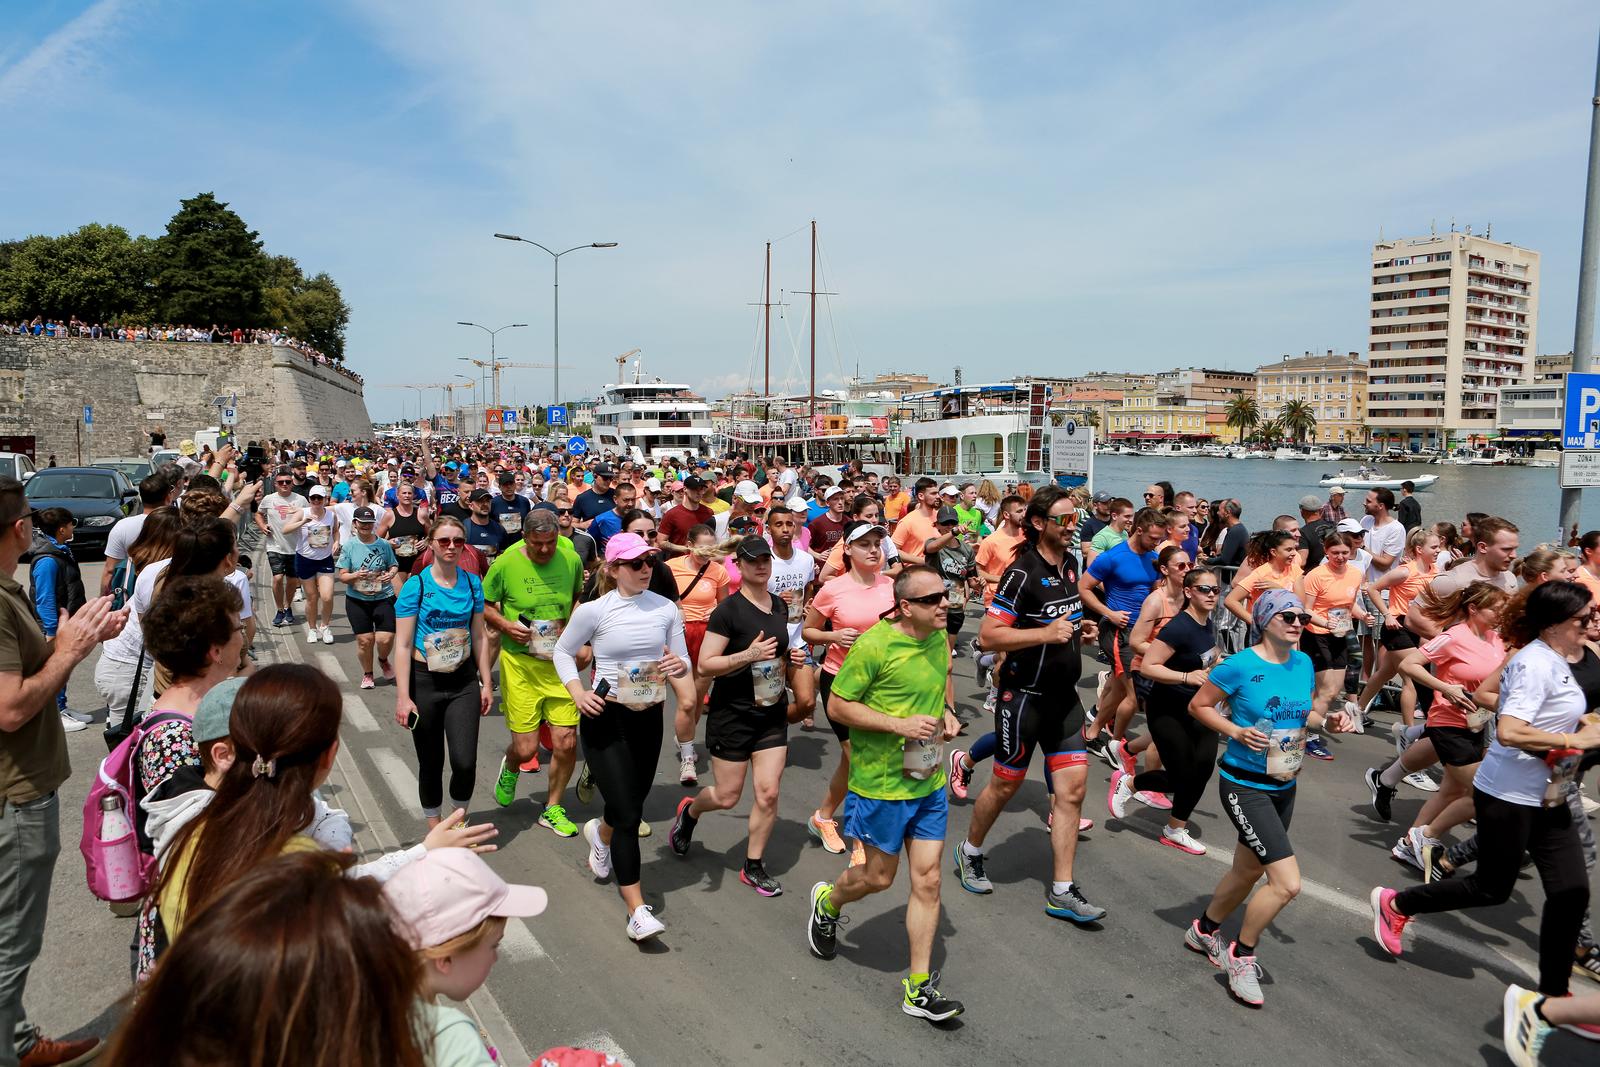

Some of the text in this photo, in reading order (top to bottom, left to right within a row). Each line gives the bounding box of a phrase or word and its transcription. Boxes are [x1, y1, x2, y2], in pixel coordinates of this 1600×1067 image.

[552, 409, 560, 422] P
[1579, 387, 1600, 433] P
[507, 412, 513, 422] P
[1577, 454, 1592, 462] ZONA
[360, 547, 380, 569] TEAM
[775, 573, 803, 583] ZADAR
[776, 581, 804, 590] ZADAR
[1058, 600, 1083, 615] GIAN
[441, 650, 460, 662] 51022
[1250, 674, 1265, 683] 4F
[633, 688, 653, 697] 52403
[1002, 718, 1011, 755] GIANT
[1228, 792, 1267, 857] ellesse
